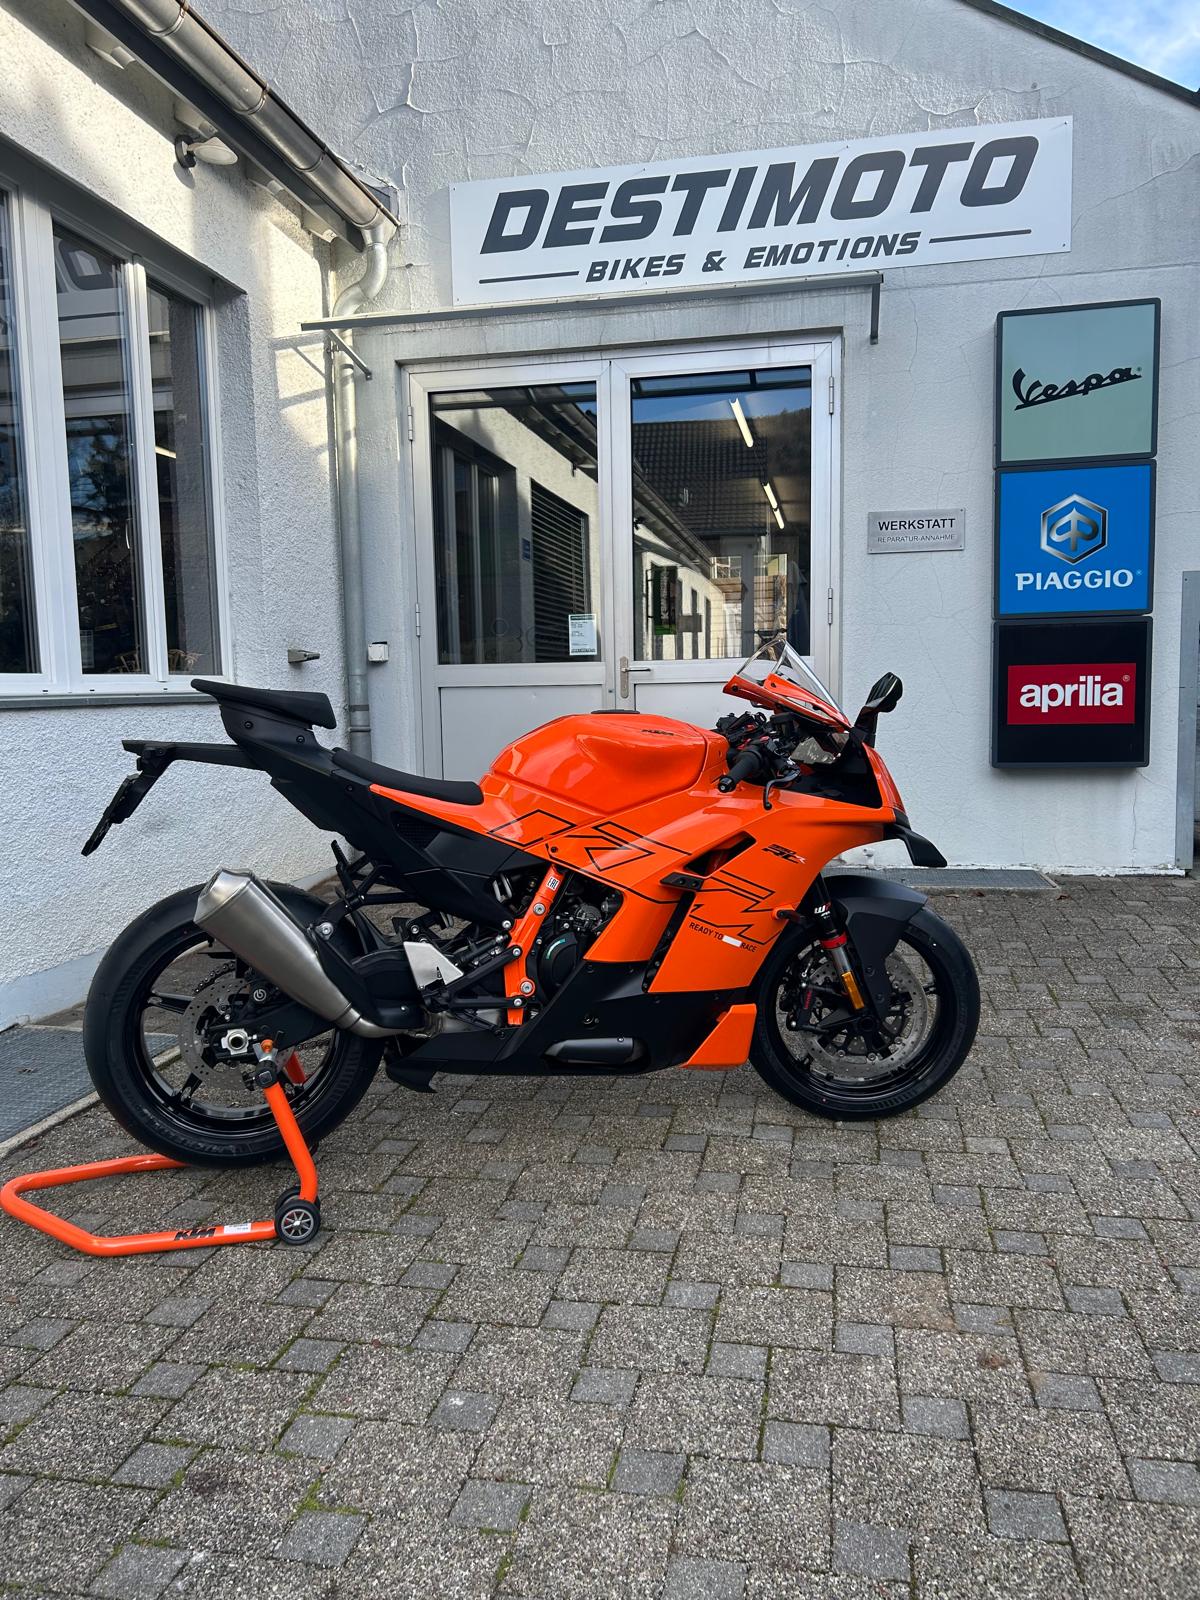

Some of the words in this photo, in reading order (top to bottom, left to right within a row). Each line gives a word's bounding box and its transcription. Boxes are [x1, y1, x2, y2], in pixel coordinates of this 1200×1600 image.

[480, 135, 1040, 255] DESTIMOTO
[585, 251, 687, 284] BIKES
[701, 250, 725, 273] &
[743, 231, 922, 270] EMOTIONS
[1012, 367, 1142, 411] Vespa
[877, 534, 956, 544] REPARATUR-ANNAHME
[878, 518, 956, 531] WERKSTATT
[1015, 569, 1134, 591] PIAGGIO
[1019, 675, 1124, 713] aprilia
[689, 922, 714, 937] READY
[713, 931, 724, 941] TO
[740, 942, 758, 953] RACE
[174, 1227, 217, 1241] KTM
